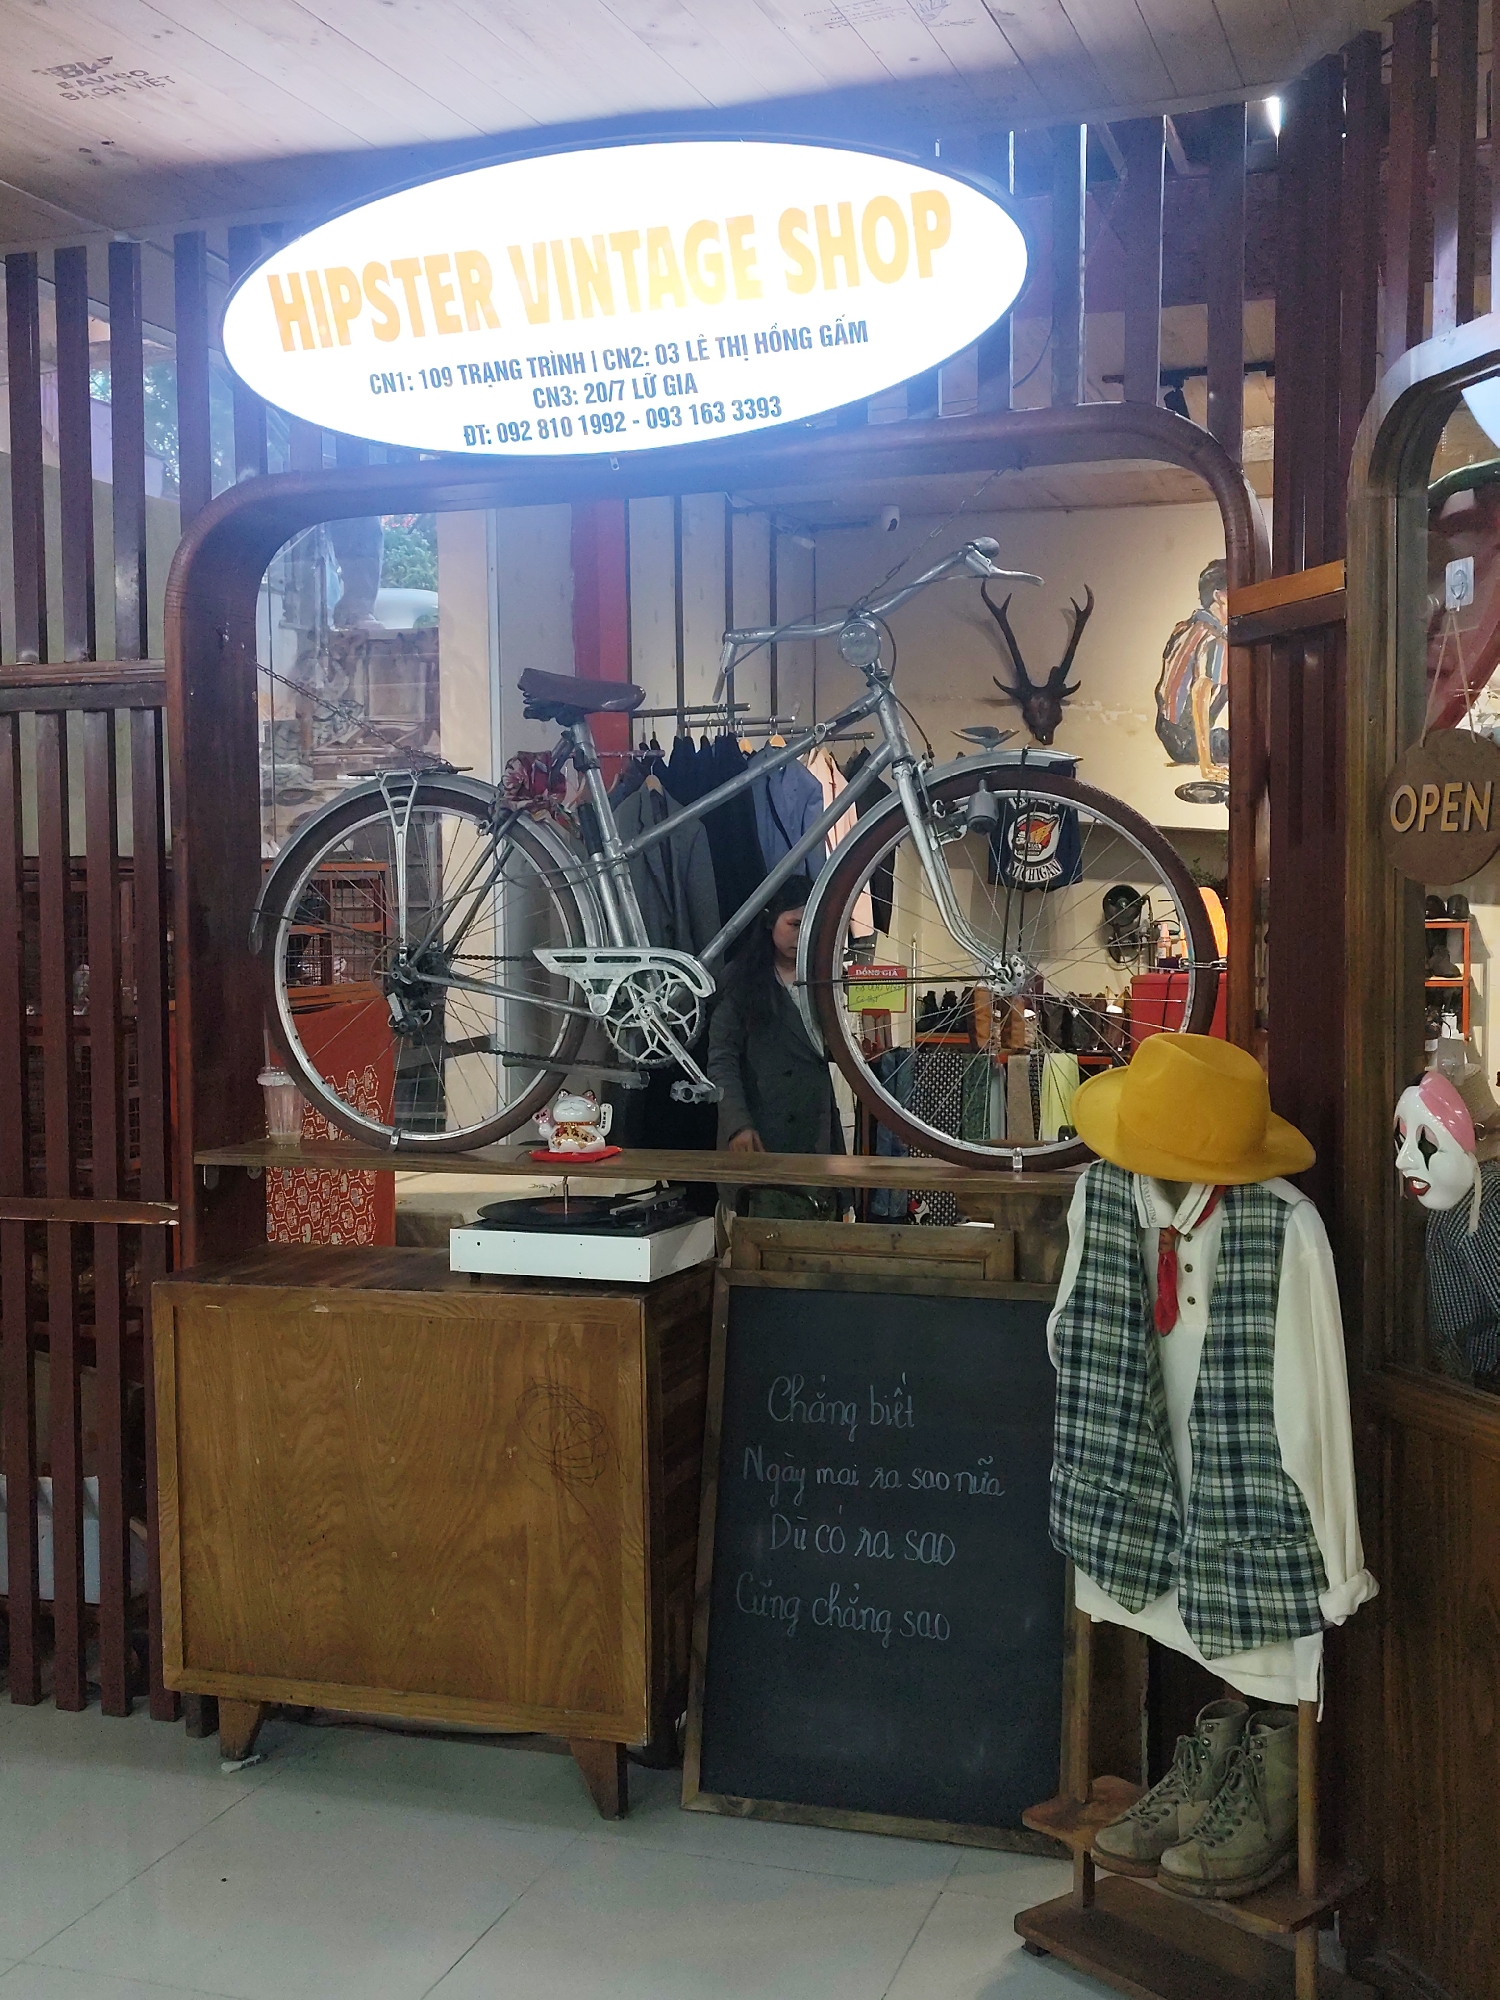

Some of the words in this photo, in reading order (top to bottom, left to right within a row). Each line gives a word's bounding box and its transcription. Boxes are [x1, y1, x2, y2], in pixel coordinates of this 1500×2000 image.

[267, 250, 501, 352] HIPSTER
[507, 215, 764, 324] VINTAGE
[778, 190, 951, 294] SHOP
[369, 372, 414, 394] CN1:
[418, 366, 454, 389] 109
[456, 358, 523, 388] TRẠNG
[526, 350, 586, 380] TRÌNH
[602, 347, 650, 371] CN2:
[655, 343, 680, 366] 03
[686, 334, 711, 362] LÊ
[715, 334, 749, 361] THỊ
[754, 323, 813, 355] HỒNG
[818, 314, 869, 348] GẤM
[463, 423, 492, 447] ĐT:
[497, 419, 532, 444] 092
[537, 415, 573, 440] 810
[577, 410, 627, 436] 1992
[645, 405, 684, 430] 093
[688, 400, 726, 426] 163
[731, 395, 783, 421] 3393
[532, 386, 579, 409] CN3:
[583, 379, 626, 405] 20/7
[631, 373, 657, 400] LỮ
[662, 373, 699, 398] GIA
[1390, 780, 1492, 833] OPEN
[768, 1374, 858, 1442] Chẳng
[869, 1371, 916, 1429] biết
[743, 1445, 806, 1508] Ngày
[815, 1463, 860, 1488] mai
[869, 1467, 902, 1490] ra
[908, 1466, 950, 1491] sao
[815, 1504, 847, 1554] có
[854, 1525, 896, 1561] ra
[904, 1529, 956, 1567] sao
[736, 1571, 802, 1638] Cũng
[811, 1582, 893, 1649] chẳng
[899, 1608, 951, 1642] sao
